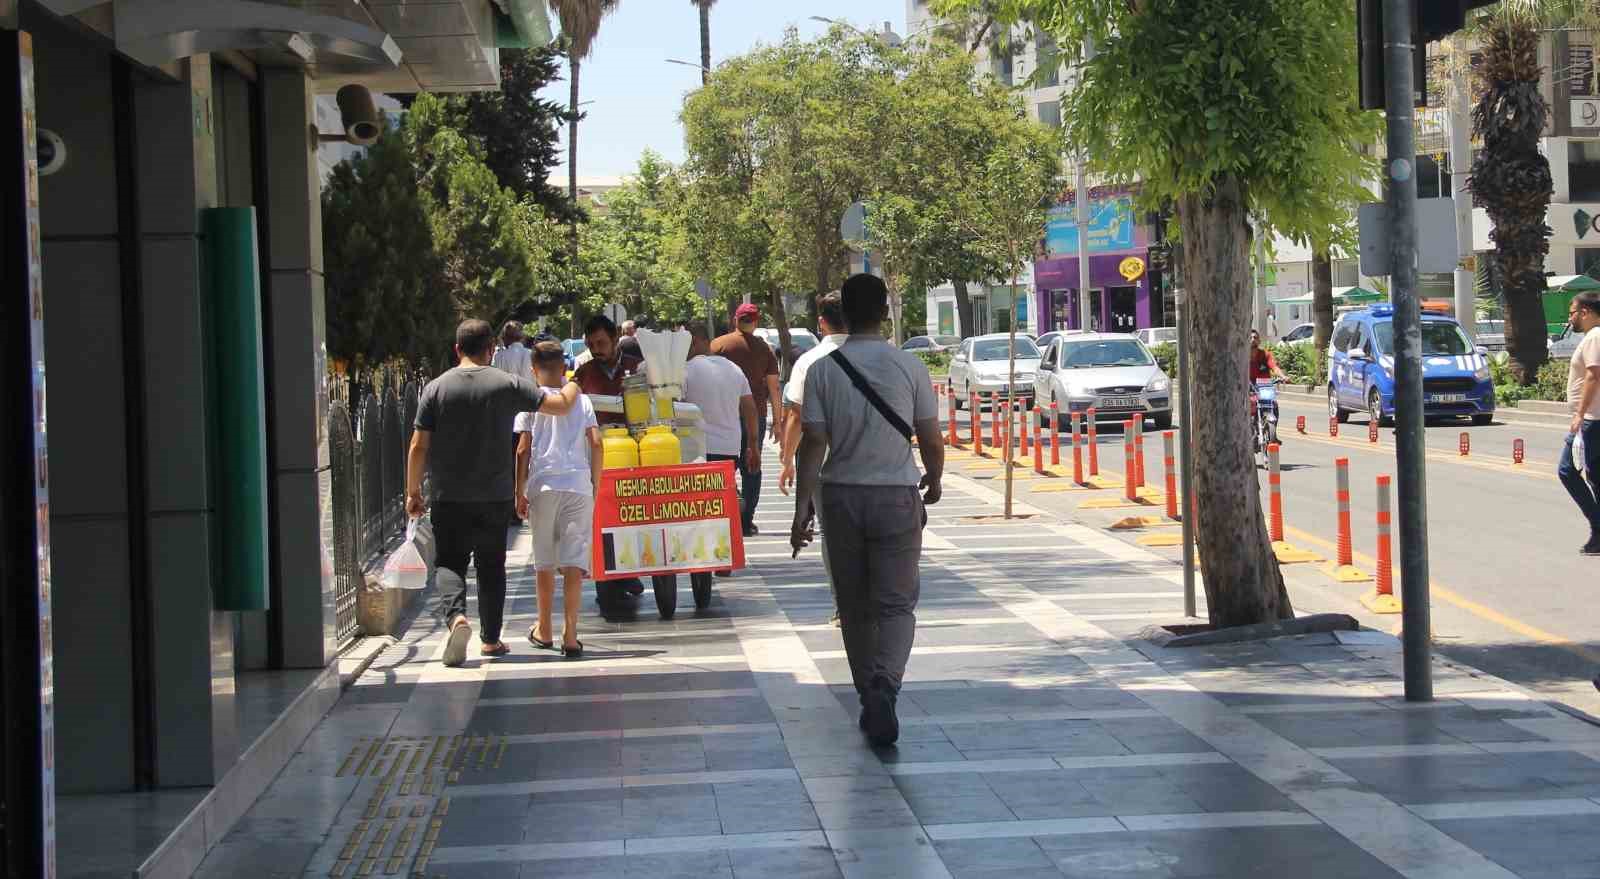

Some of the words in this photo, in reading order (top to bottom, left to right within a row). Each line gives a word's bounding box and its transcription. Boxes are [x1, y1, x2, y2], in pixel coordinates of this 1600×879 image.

[649, 475, 690, 495] ABDULLAH
[691, 472, 724, 491] USTANIN
[620, 502, 650, 522] ÖZEL
